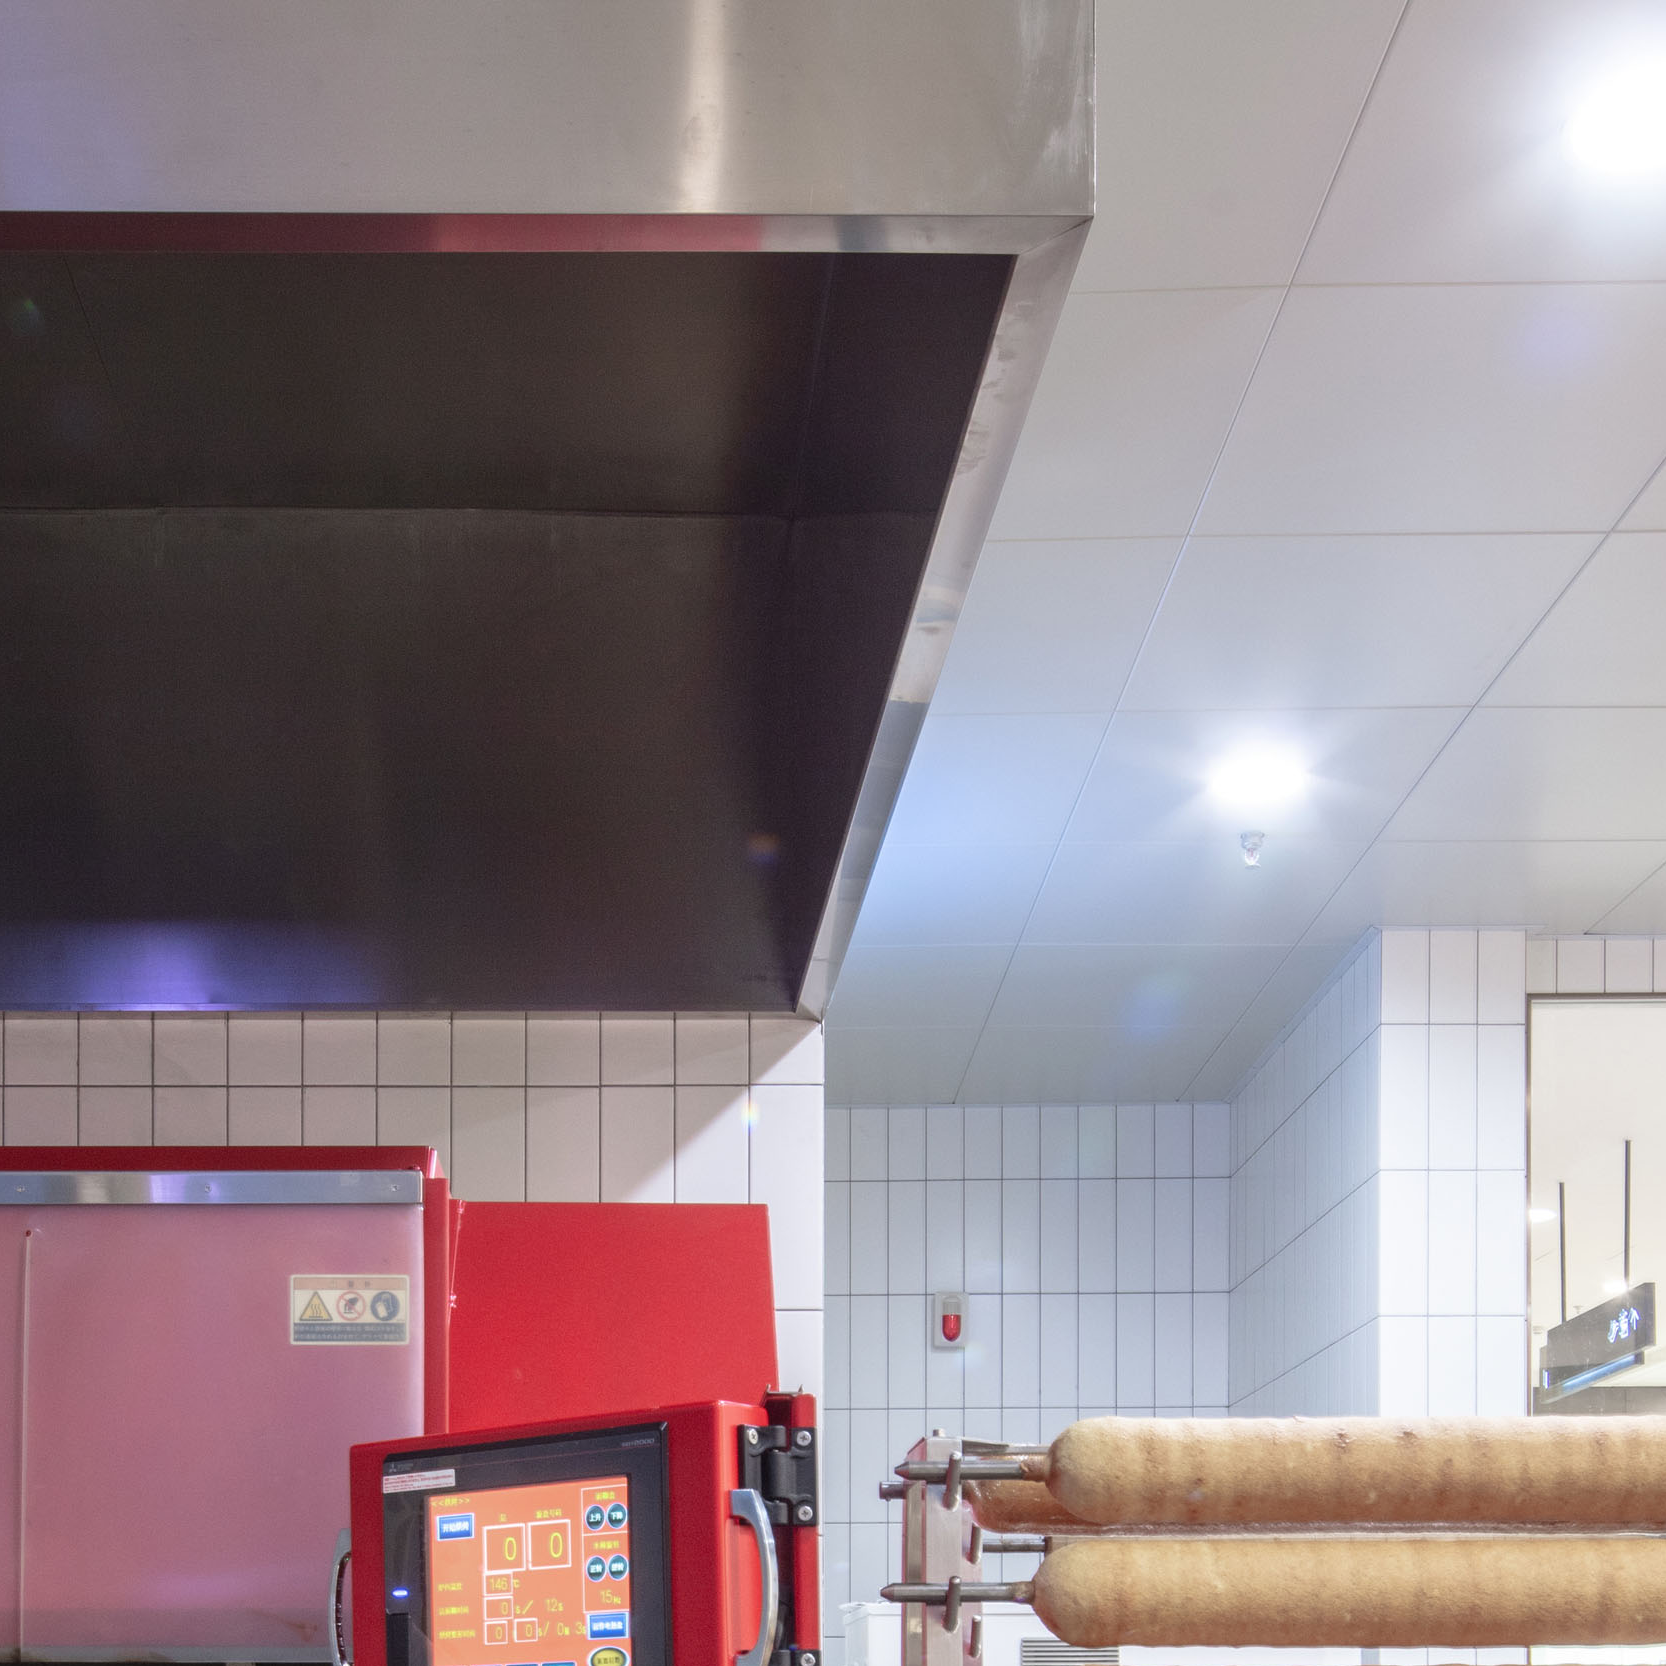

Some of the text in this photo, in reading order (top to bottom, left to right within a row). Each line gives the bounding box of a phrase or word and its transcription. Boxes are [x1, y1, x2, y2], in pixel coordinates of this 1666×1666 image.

[504, 1537, 517, 1561] 0
[549, 1532, 563, 1558] 0
[489, 1578, 508, 1591] 146
